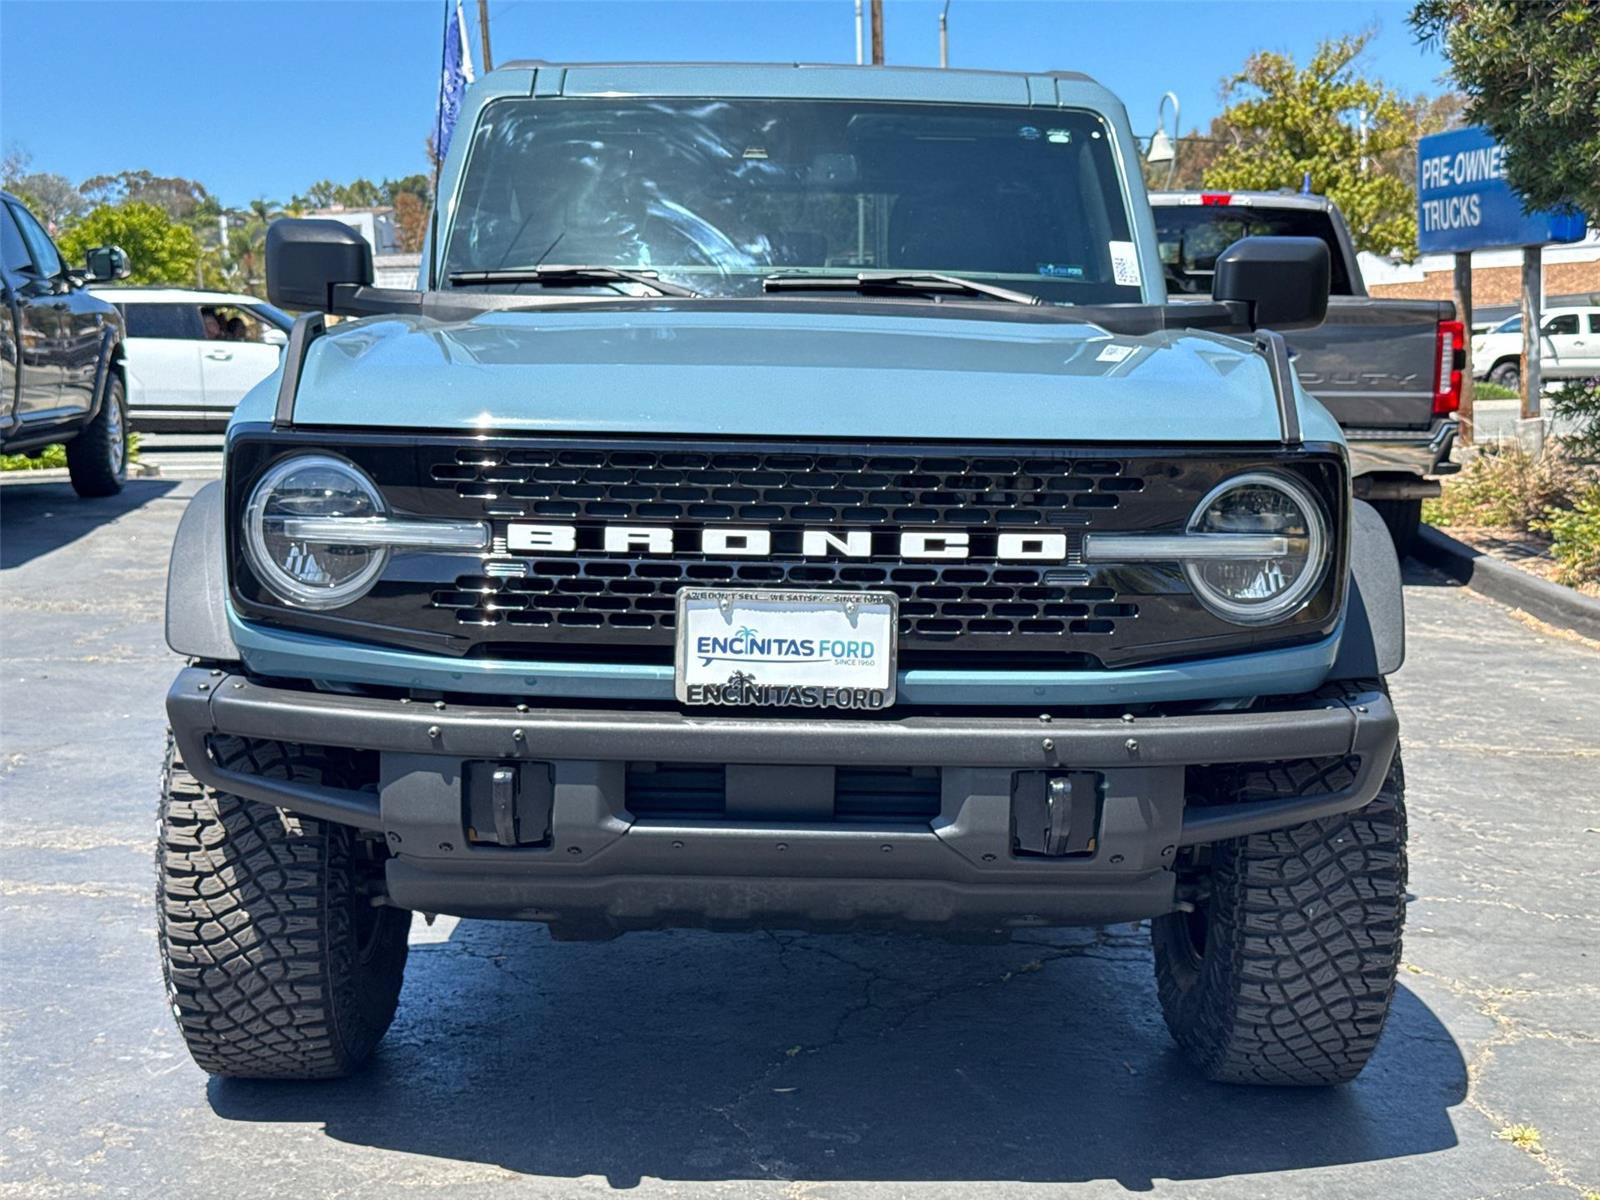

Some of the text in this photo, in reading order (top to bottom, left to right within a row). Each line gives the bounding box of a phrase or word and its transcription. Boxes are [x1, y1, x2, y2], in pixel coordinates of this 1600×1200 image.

[1422, 194, 1480, 232] TRUCKS
[1298, 373, 1418, 385] DUTY
[506, 522, 1067, 561] BRONCO
[770, 593, 785, 602] WE
[697, 635, 875, 659] ENCINITAS FORD
[686, 683, 886, 709] ENCINITAS FORD
